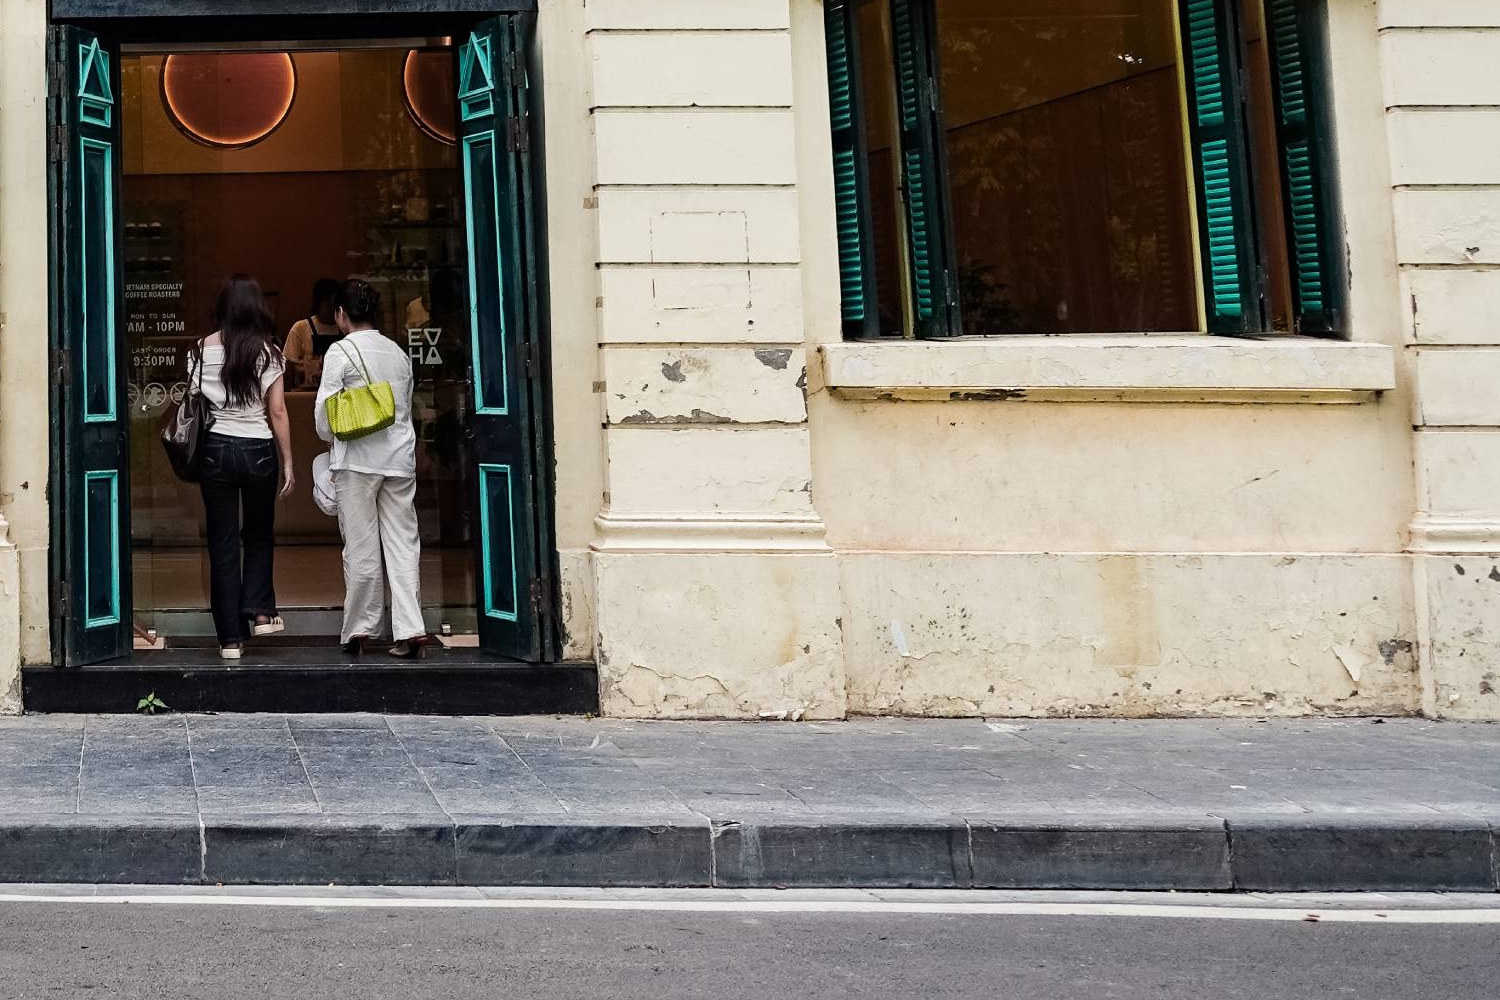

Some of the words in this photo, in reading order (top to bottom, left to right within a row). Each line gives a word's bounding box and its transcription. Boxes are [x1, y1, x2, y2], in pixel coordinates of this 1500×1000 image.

[126, 283, 150, 291] IETNAM
[126, 321, 145, 333] AM
[156, 321, 185, 332] 10PM
[133, 355, 175, 367] 9:30PM
